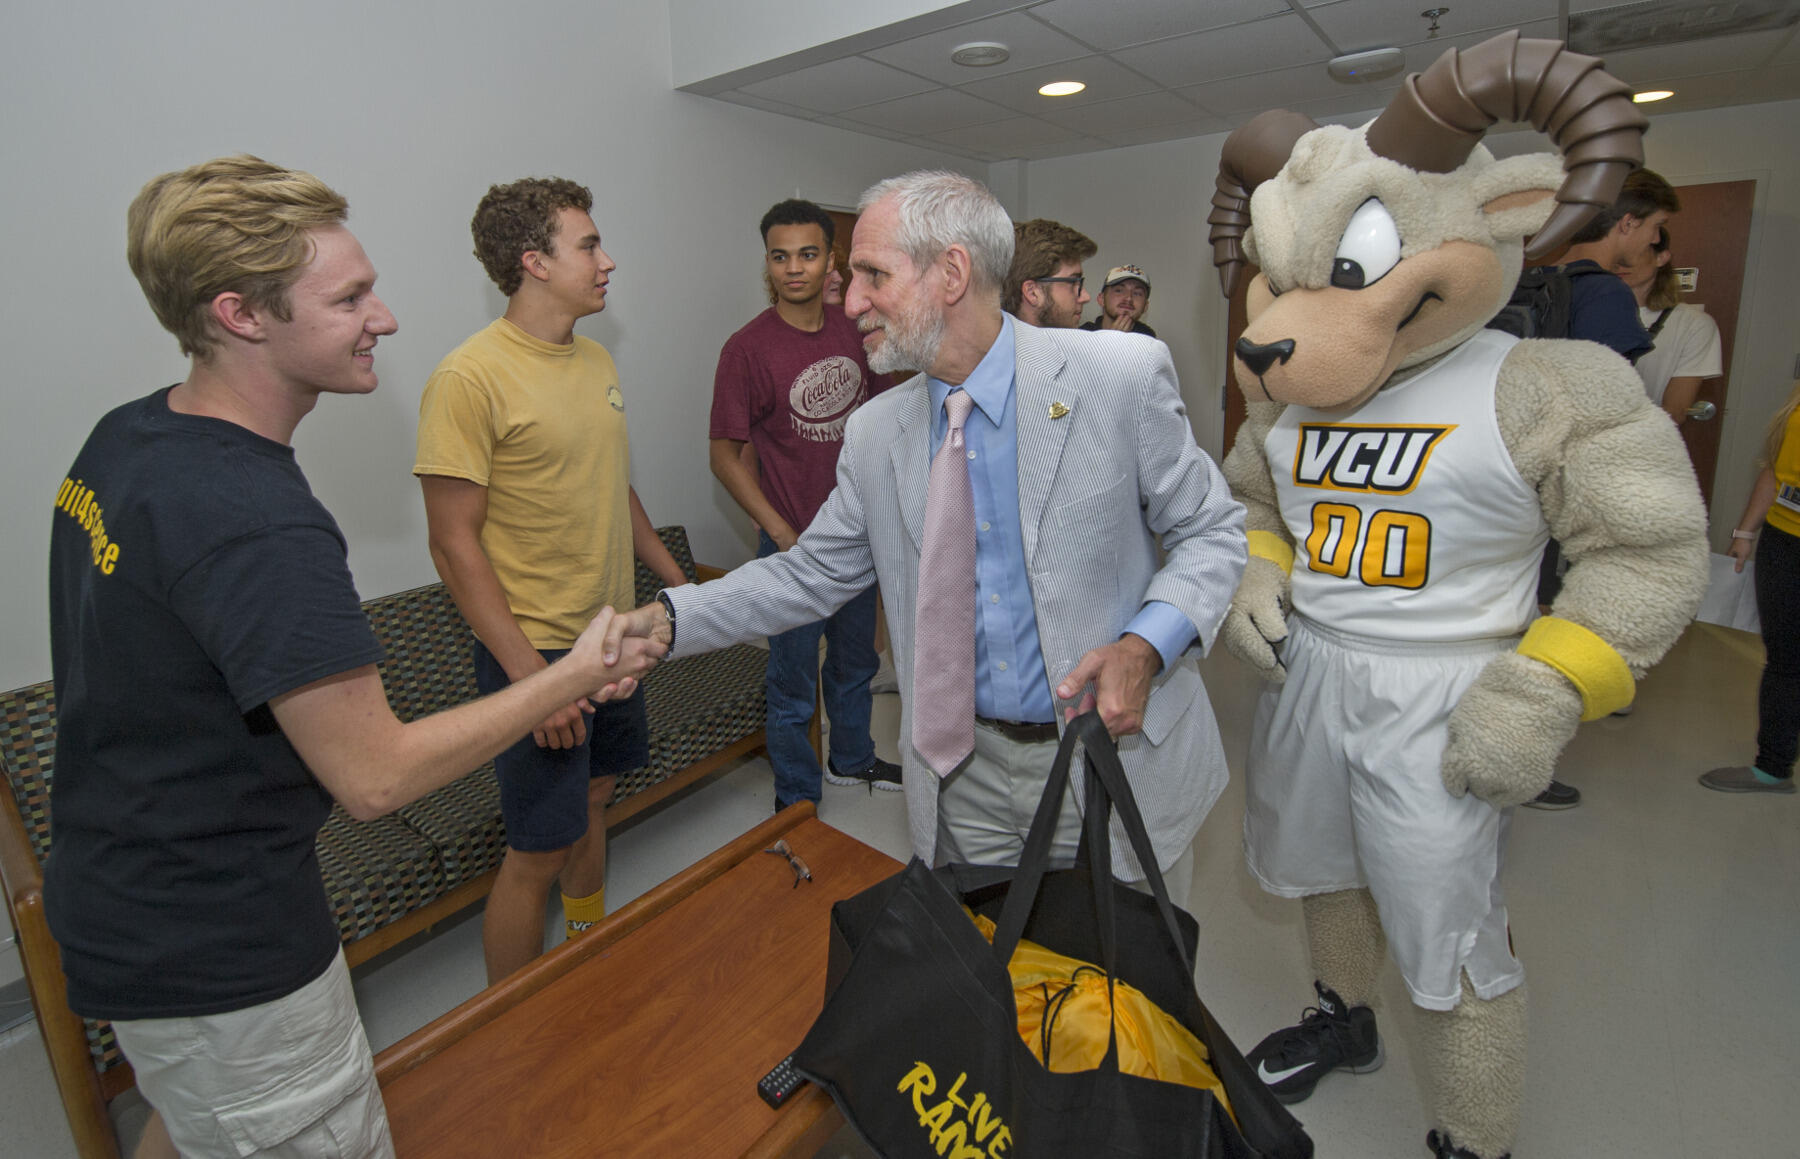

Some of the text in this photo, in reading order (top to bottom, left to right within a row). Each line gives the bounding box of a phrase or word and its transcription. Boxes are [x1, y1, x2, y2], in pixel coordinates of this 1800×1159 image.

[1296, 426, 1447, 491] VCU
[1305, 501, 1432, 590] 00
[571, 920, 596, 931] VC
[947, 1072, 1013, 1159] LIVE
